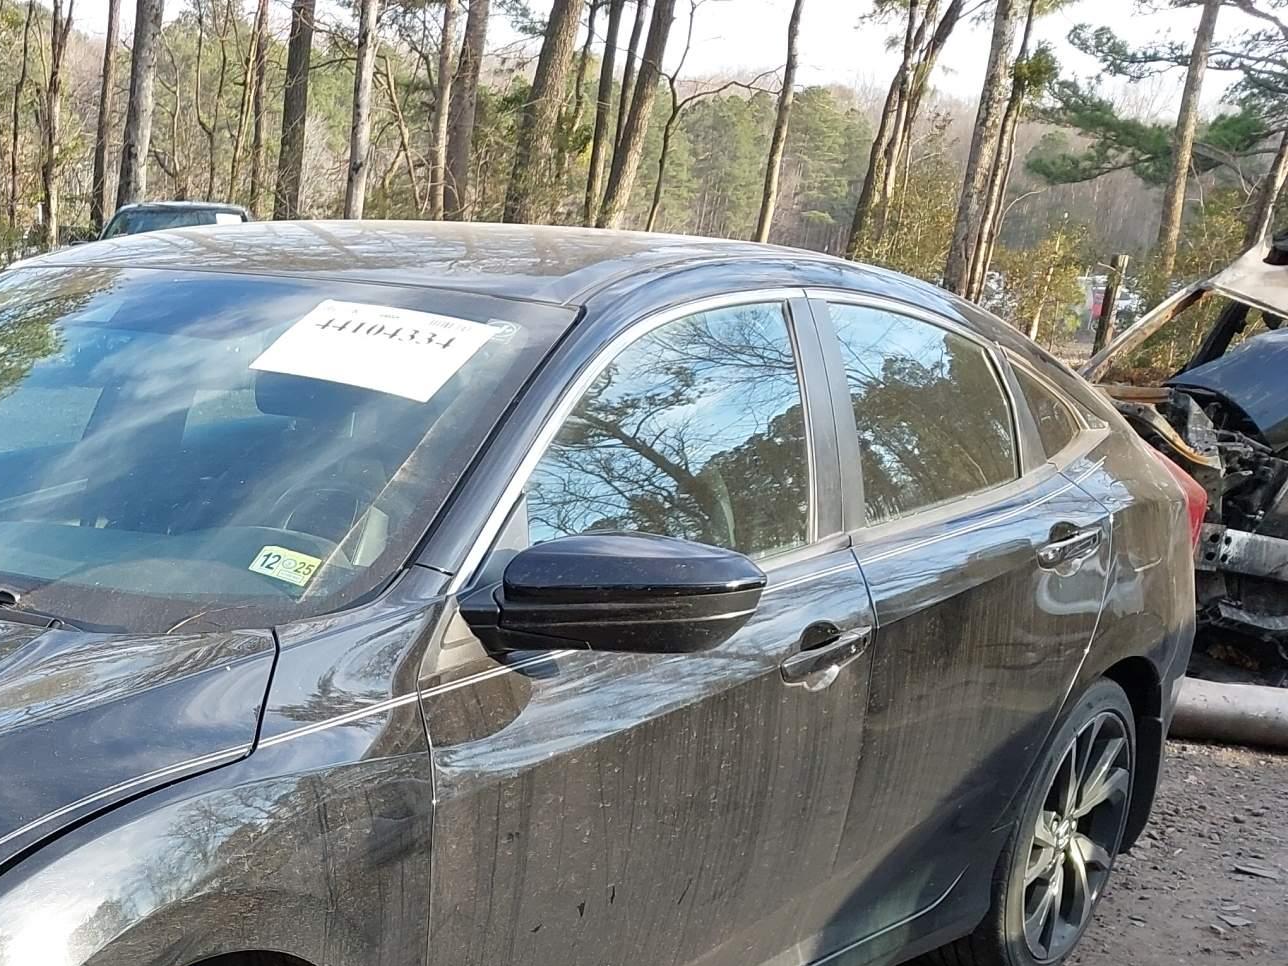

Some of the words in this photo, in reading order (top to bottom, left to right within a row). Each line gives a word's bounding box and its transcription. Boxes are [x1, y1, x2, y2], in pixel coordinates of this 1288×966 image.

[314, 317, 457, 350] 44104334
[260, 552, 282, 571] 12
[293, 561, 316, 576] 25
